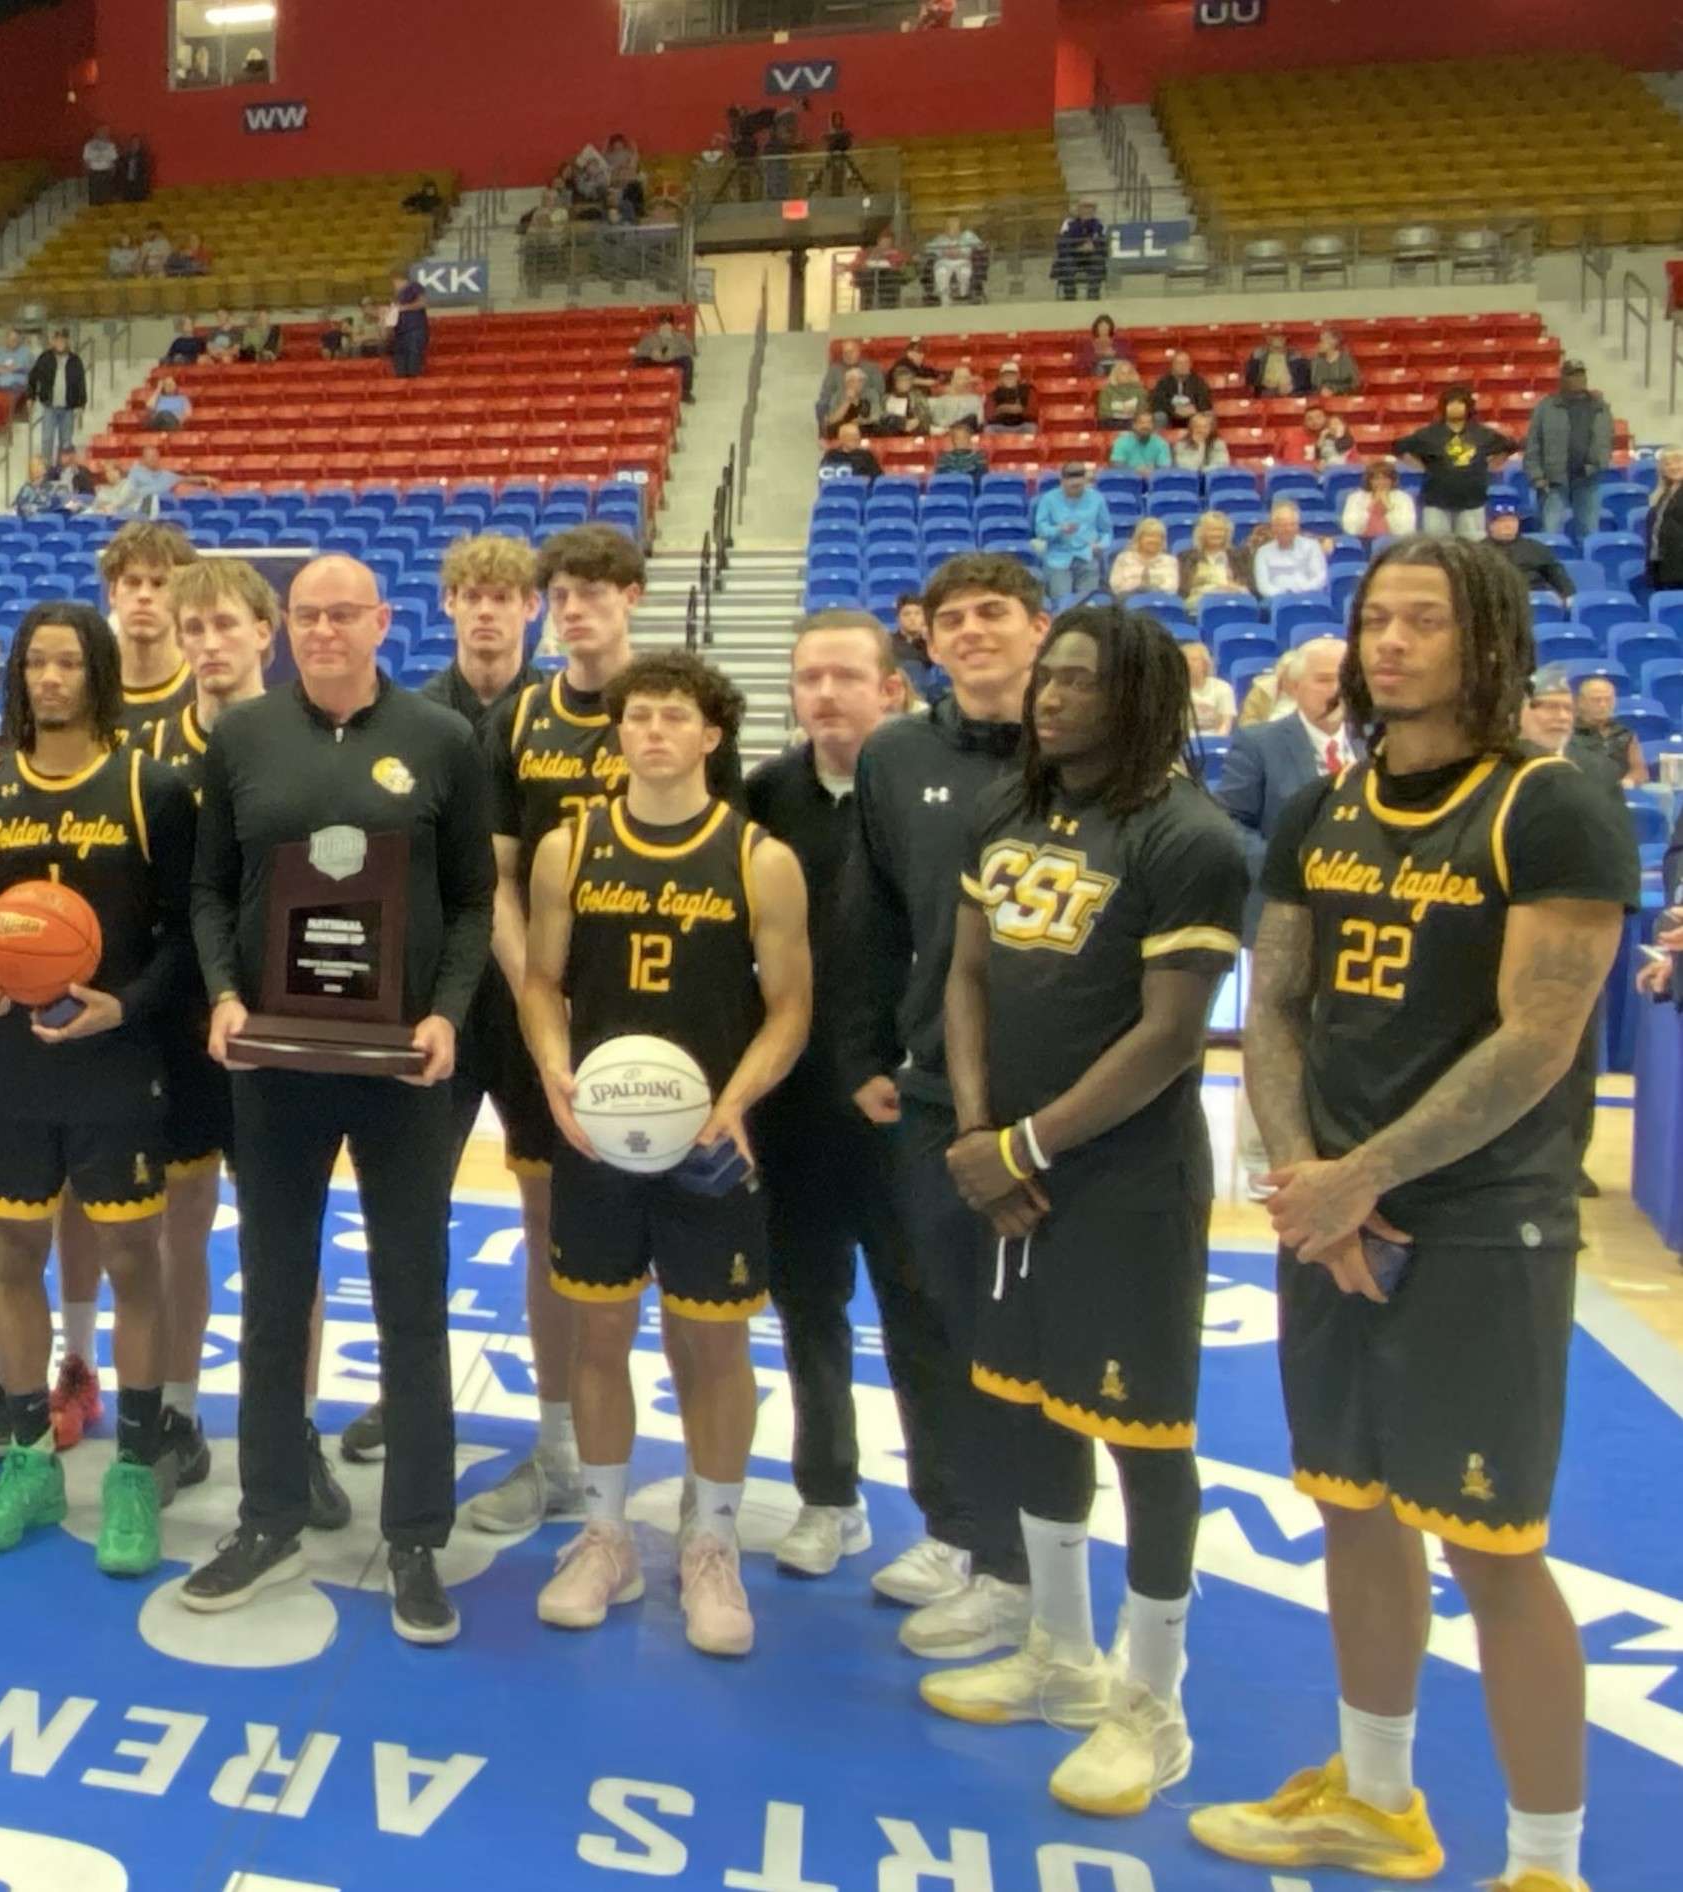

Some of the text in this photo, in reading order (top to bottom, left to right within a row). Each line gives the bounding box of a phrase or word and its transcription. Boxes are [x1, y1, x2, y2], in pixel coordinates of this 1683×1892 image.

[770, 65, 832, 91] VV
[245, 105, 307, 130] WW
[1110, 229, 1166, 257] LL
[418, 266, 481, 293] KK
[519, 748, 586, 780] Golden
[58, 810, 129, 860] Eagles
[576, 880, 737, 934] Golden Eagles
[961, 842, 1113, 948] CSI
[1390, 855, 1485, 923] Eagles
[629, 932, 673, 993] 12
[1334, 919, 1413, 1000] 22
[589, 1080, 684, 1106] SPALDING
